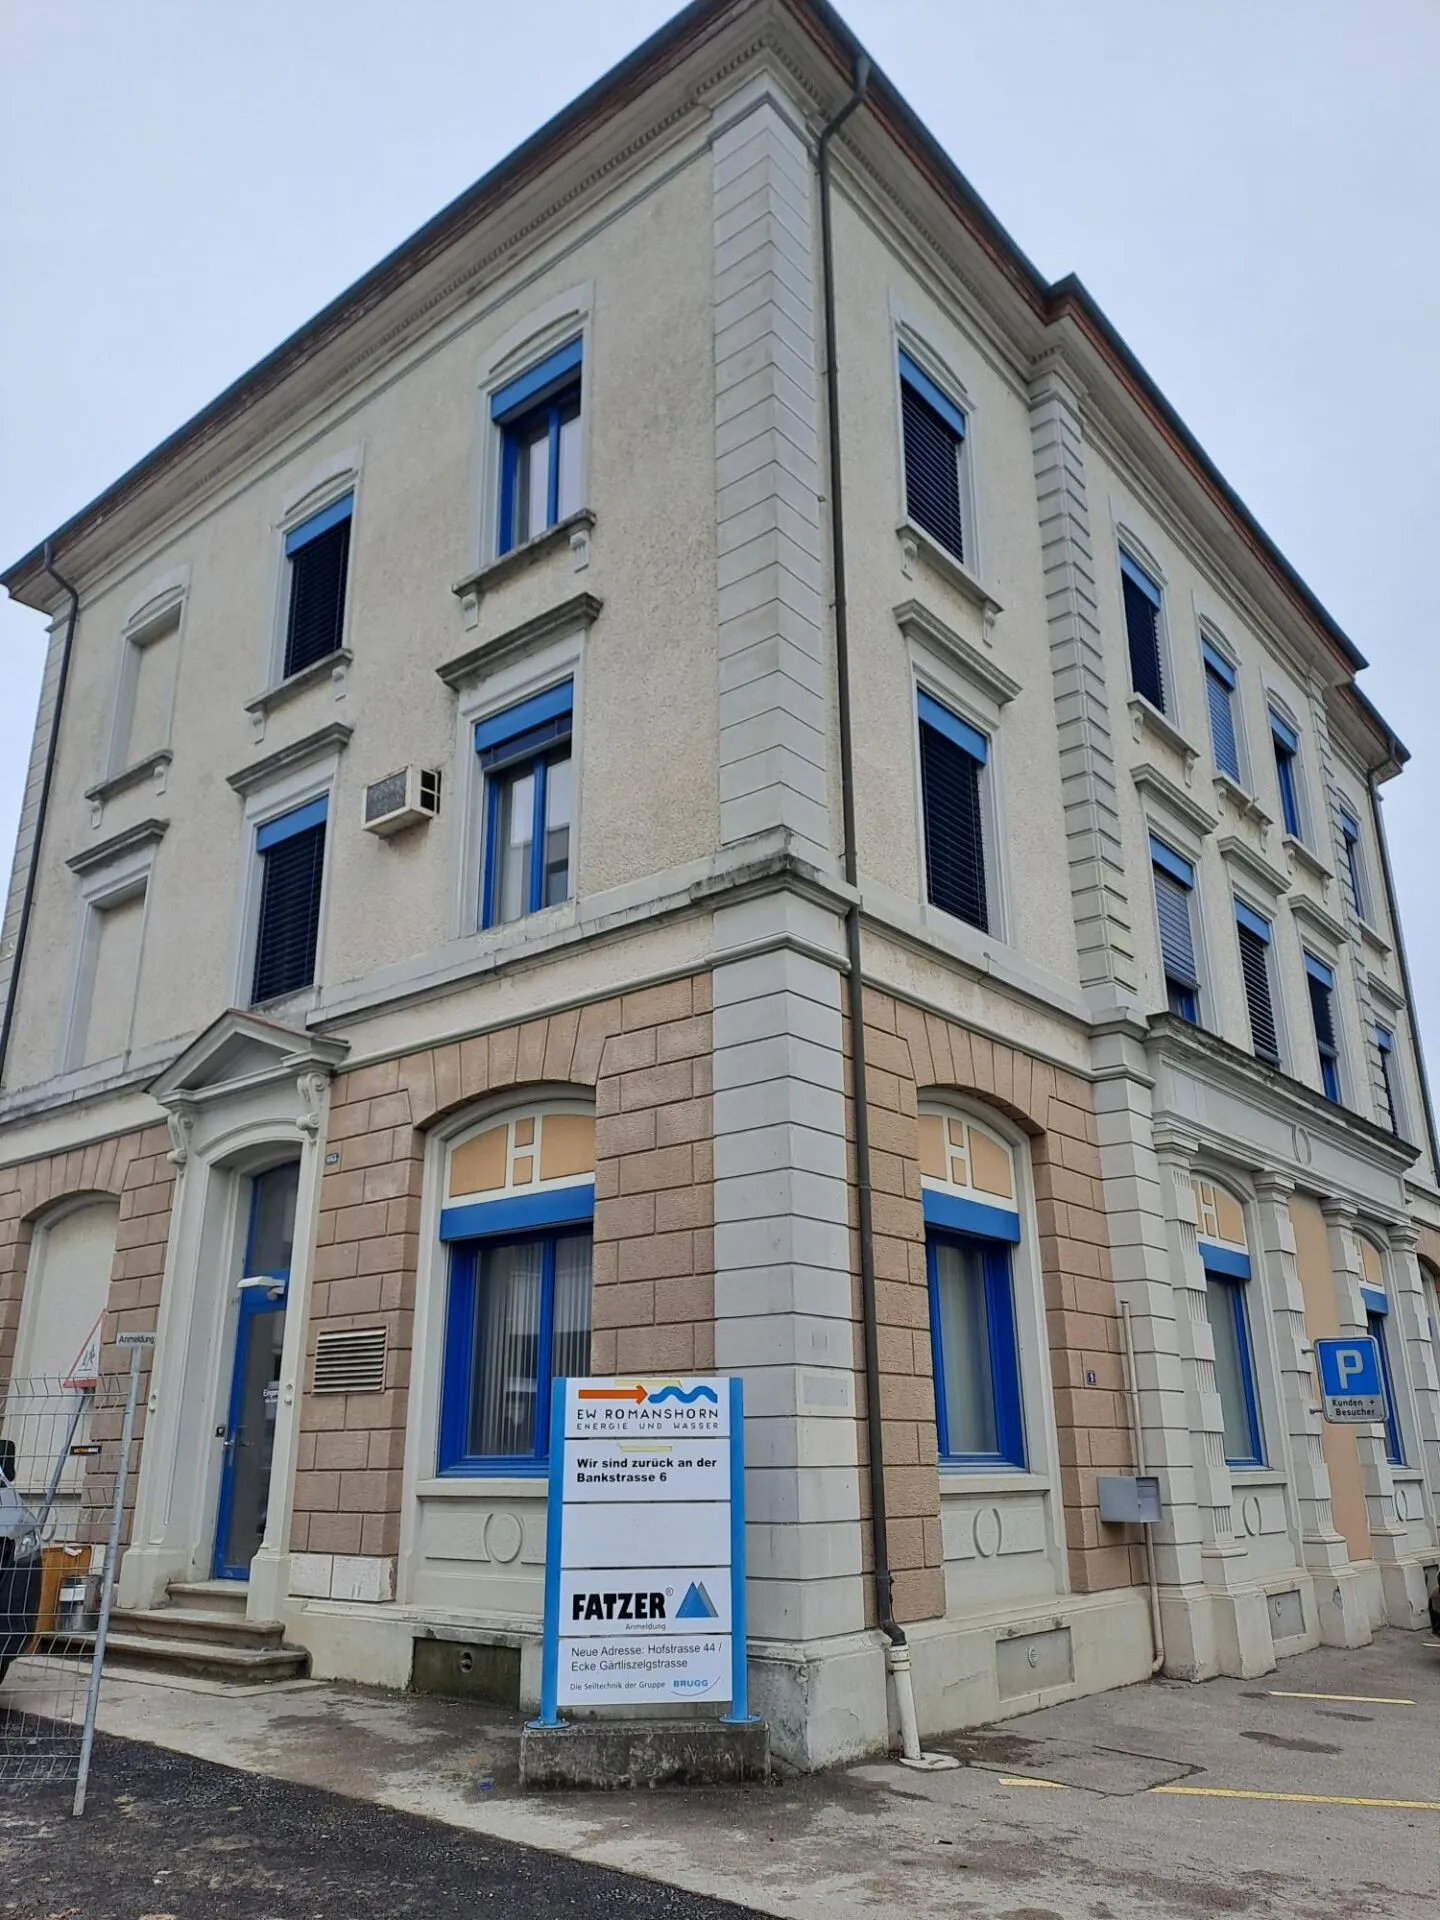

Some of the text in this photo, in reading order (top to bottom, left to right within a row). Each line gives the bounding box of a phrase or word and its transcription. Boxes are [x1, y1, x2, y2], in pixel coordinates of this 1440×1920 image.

[119, 1335, 155, 1344] Anmeldung
[1336, 1349, 1364, 1389] P
[1332, 1399, 1363, 1407] Kunden
[577, 1408, 718, 1419] EW ROMANSHORN
[1335, 1408, 1375, 1416] Besucher
[576, 1422, 718, 1430] ENERGIE UND WASSER
[577, 1458, 717, 1468] Wir sind zurück an der
[576, 1473, 667, 1483] Bankstrasse 6
[625, 1623, 666, 1632] Anmeldung
[571, 1647, 598, 1657] Neue
[601, 1646, 644, 1656] Adresse:
[648, 1644, 701, 1655] Hofstrasse
[703, 1643, 716, 1653] 44
[571, 1661, 597, 1672] Ecke
[570, 1683, 582, 1691] Die
[584, 1682, 622, 1690] Seiltechnik
[639, 1681, 666, 1690] Gruppe
[673, 1679, 709, 1687] BRUGG
